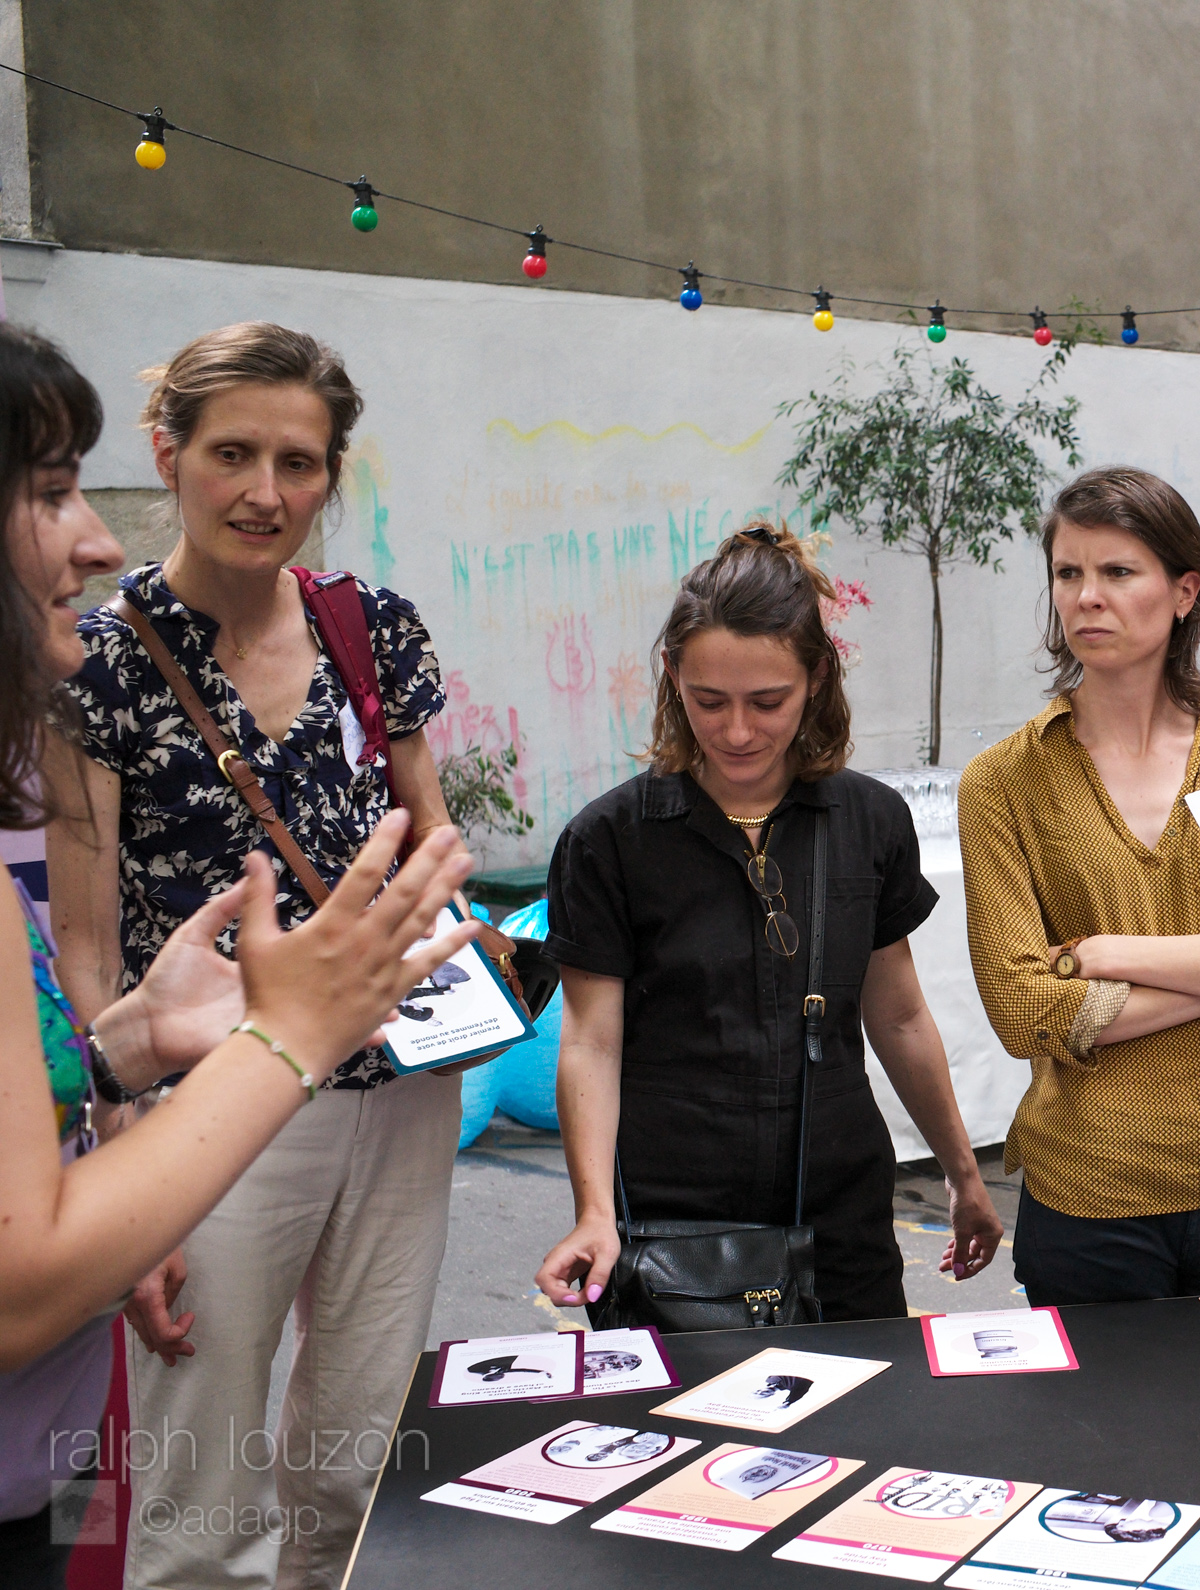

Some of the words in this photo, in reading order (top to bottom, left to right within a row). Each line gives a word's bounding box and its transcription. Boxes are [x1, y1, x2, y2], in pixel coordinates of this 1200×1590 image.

[543, 528, 601, 570] PAS
[612, 523, 657, 570] UNE
[450, 1022, 483, 1033] femmes
[470, 1025, 500, 1036] Premier
[410, 1034, 438, 1044] monde
[448, 1034, 468, 1042] droit
[863, 1487, 1006, 1520] PRIDE
